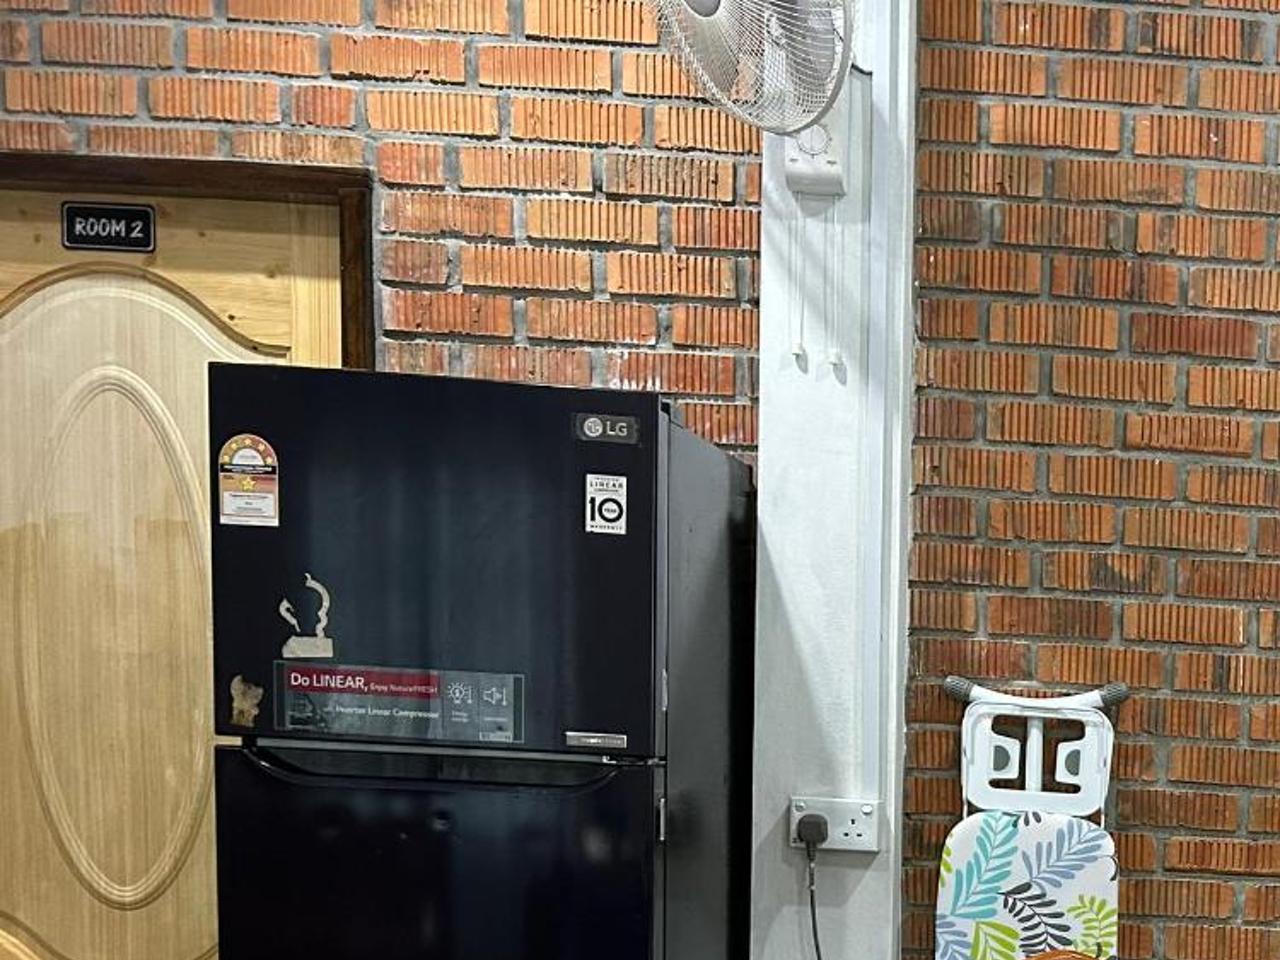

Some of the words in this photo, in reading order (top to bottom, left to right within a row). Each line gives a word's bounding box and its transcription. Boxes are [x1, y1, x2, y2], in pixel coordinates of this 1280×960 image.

[75, 217, 126, 237] ROOM
[130, 221, 144, 238] 2
[607, 421, 628, 436] LG
[589, 496, 624, 523] 10
[290, 672, 310, 686] Do
